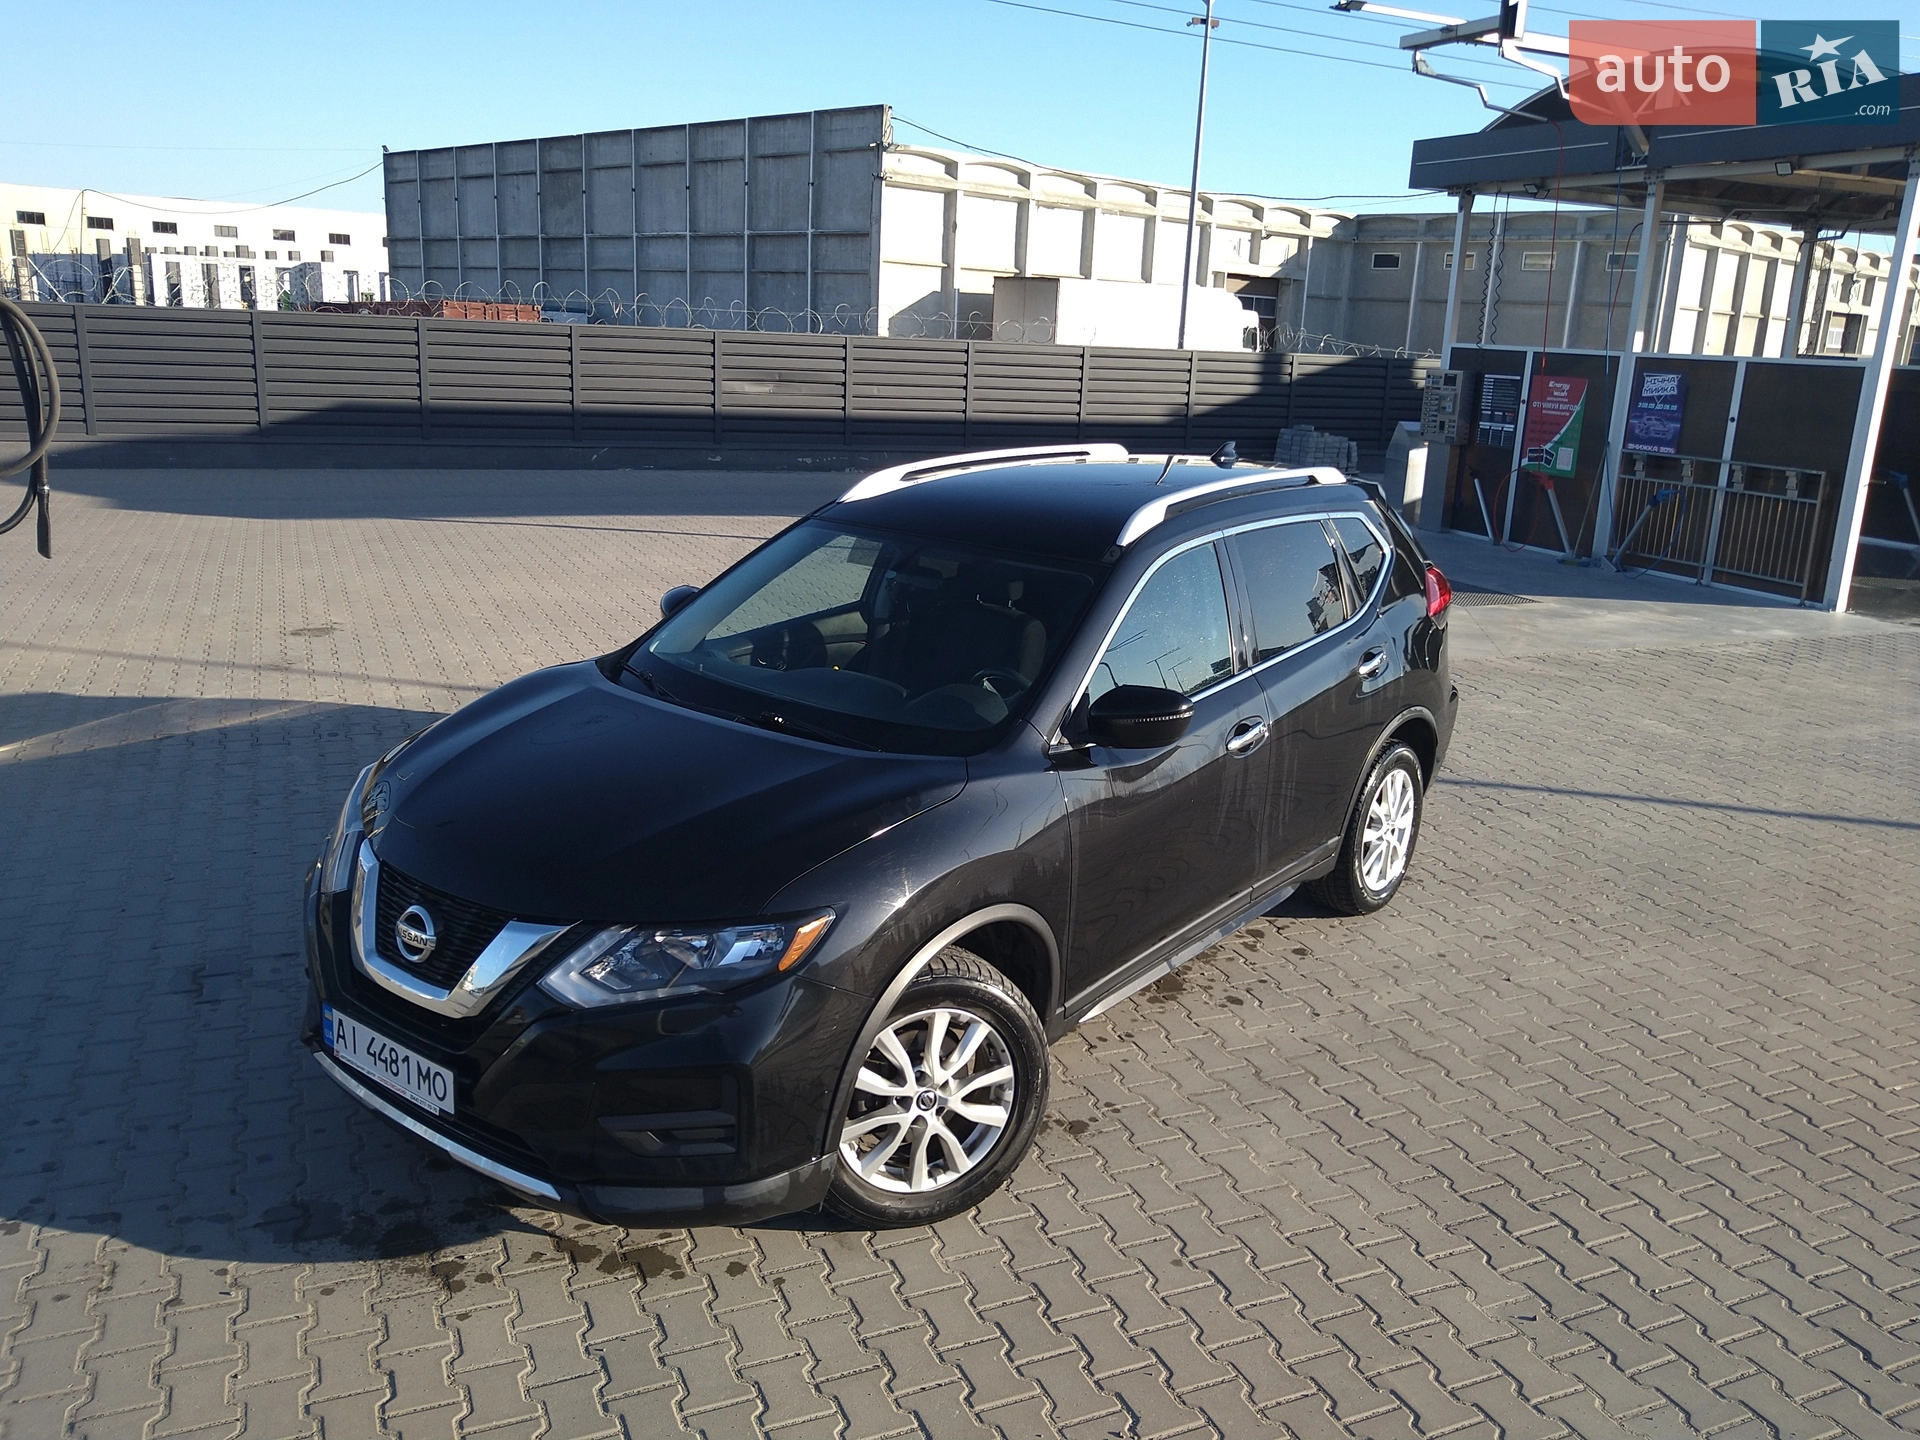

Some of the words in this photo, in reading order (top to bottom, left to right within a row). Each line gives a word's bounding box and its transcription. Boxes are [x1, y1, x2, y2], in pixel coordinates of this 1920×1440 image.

[324, 1028, 333, 1040] UA
[336, 1017, 357, 1055] AI
[366, 1036, 411, 1085] 4481
[416, 1060, 447, 1102] MO
